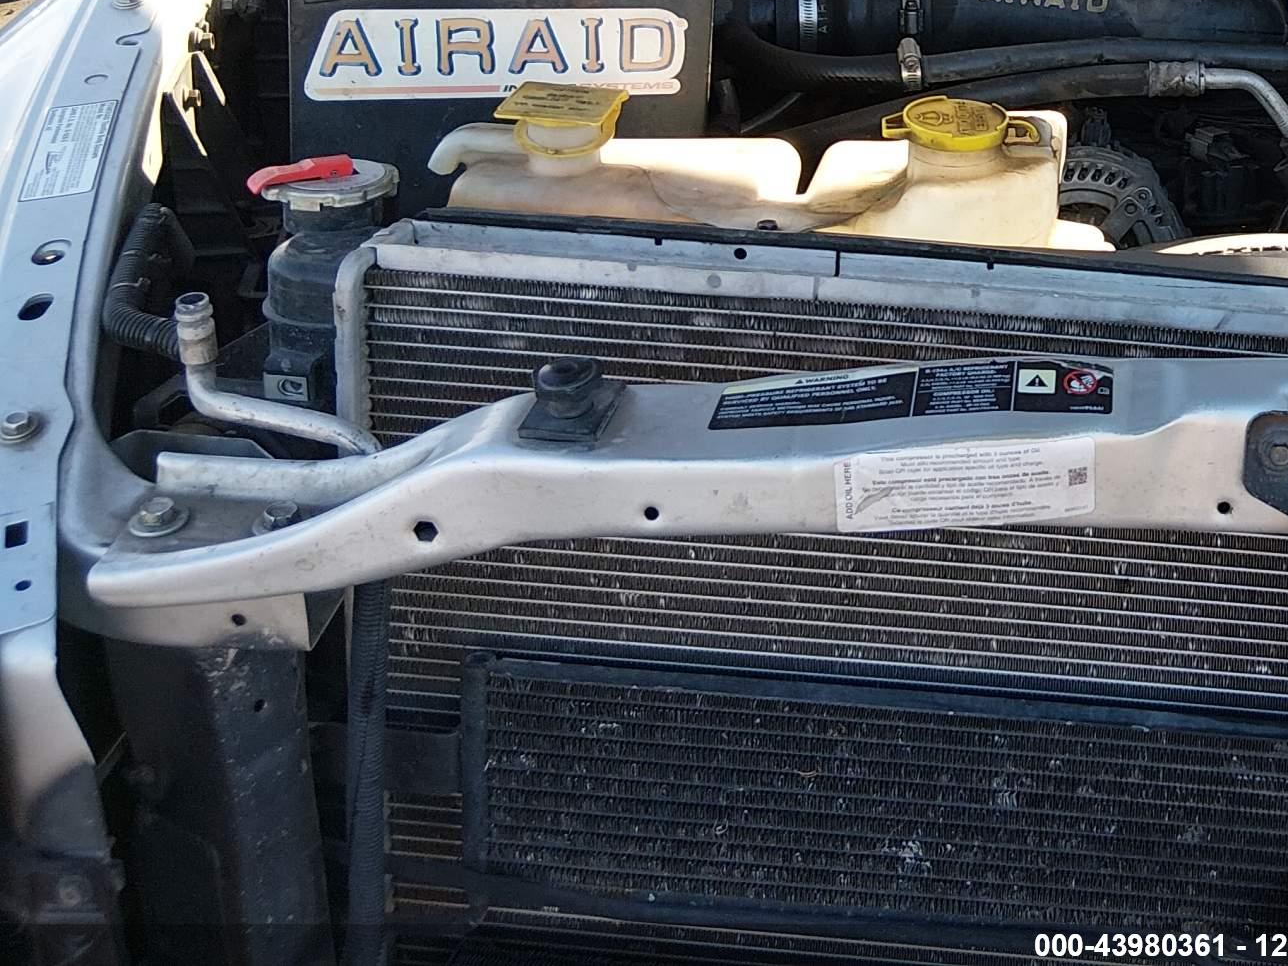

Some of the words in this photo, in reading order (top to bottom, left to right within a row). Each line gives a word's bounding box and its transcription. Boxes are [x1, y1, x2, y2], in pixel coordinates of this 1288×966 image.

[319, 16, 677, 77] AIRAID
[805, 374, 849, 383] WARNING
[842, 461, 852, 485] HERE
[844, 486, 854, 501] OIL
[845, 502, 855, 520] ADD
